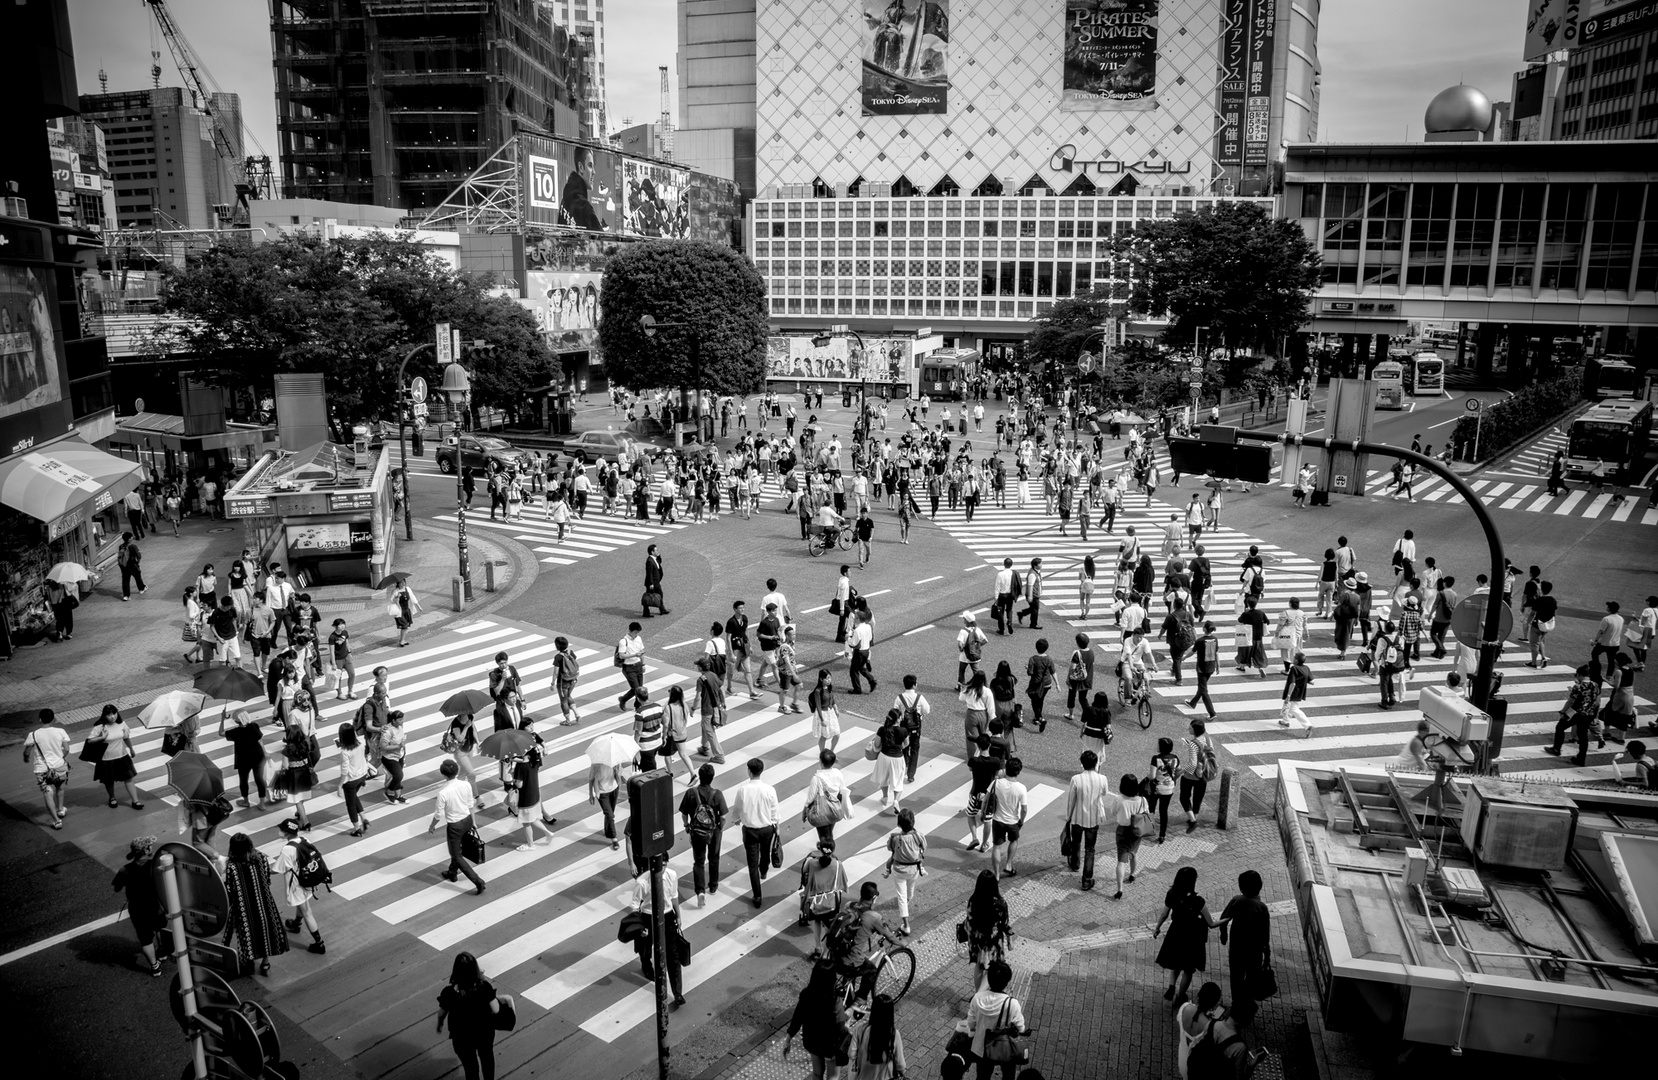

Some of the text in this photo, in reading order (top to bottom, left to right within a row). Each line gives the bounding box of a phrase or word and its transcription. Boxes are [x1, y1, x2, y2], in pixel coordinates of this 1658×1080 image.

[1069, 7, 1151, 27] PIRATES
[1078, 25, 1155, 43] SUMMER
[1224, 82, 1245, 90] SALE
[1074, 92, 1099, 100] TOKYO
[1224, 112, 1239, 156] 開催中
[1074, 161, 1191, 173] TOKYU
[52, 168, 70, 182] イク
[231, 506, 256, 515] 渋谷駅
[316, 540, 348, 550] しぶちか
